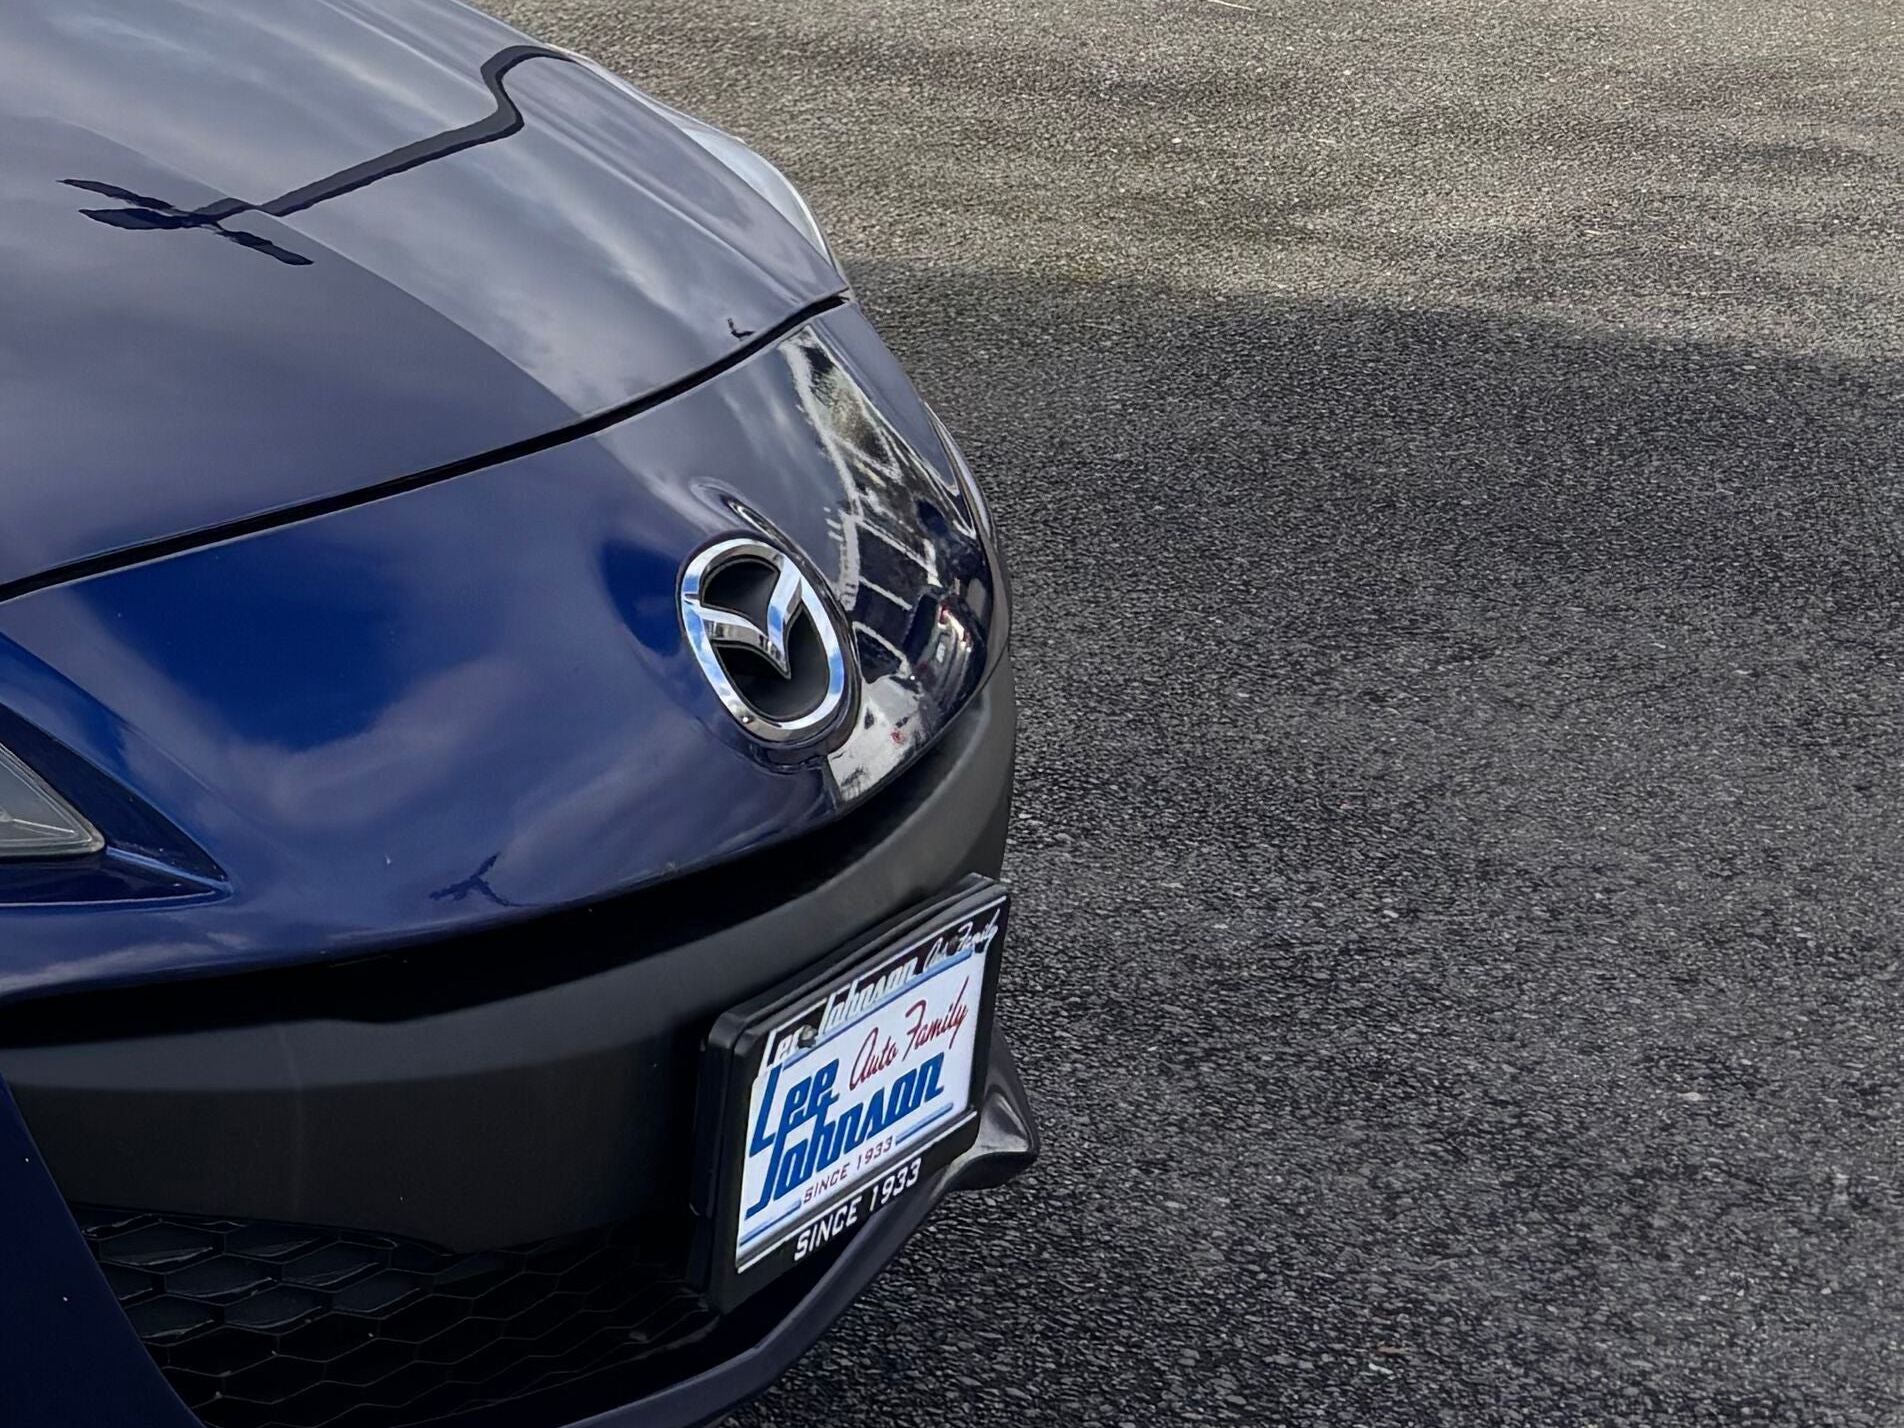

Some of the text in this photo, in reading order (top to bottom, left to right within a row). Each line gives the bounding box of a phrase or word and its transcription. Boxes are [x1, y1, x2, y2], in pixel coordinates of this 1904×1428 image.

[818, 956, 919, 1036] Johnson
[749, 975, 969, 1158] Lee Auto Family
[744, 1051, 945, 1221] Johnson
[803, 1135, 894, 1204] SINCE 1933
[793, 1157, 922, 1262] SINCE 1933
